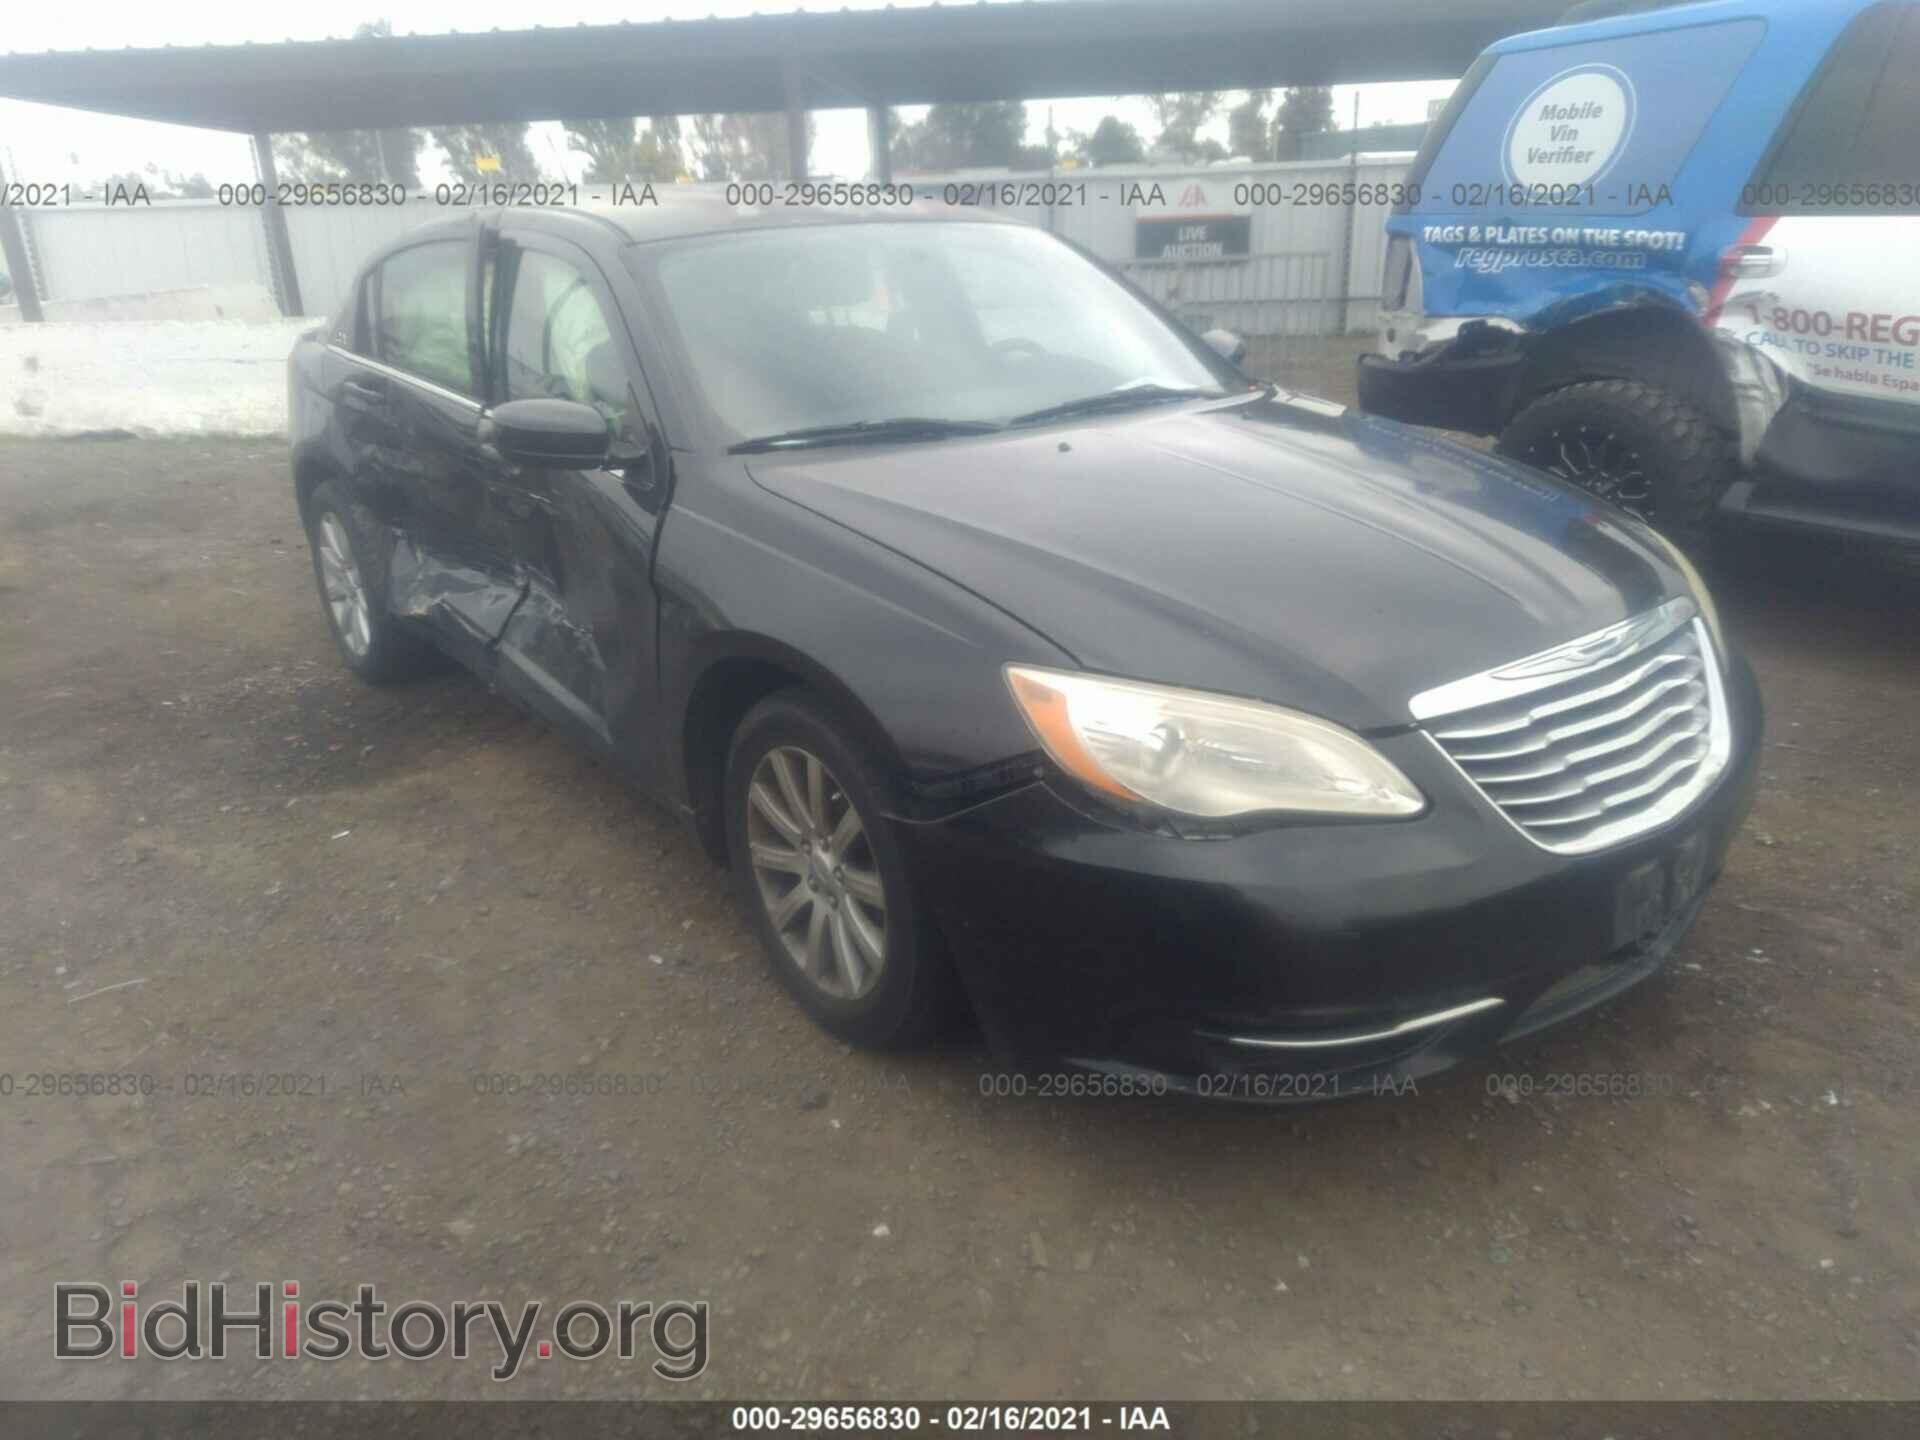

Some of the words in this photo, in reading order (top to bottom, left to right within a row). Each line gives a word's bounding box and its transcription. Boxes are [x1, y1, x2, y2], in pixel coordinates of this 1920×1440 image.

[1539, 102, 1603, 121] Mobile
[1549, 124, 1578, 142] Vin
[1526, 146, 1595, 165] Verifier
[1178, 223, 1208, 241] LIVE
[1424, 226, 1464, 242] TAGS
[1468, 226, 1481, 241] &
[1485, 227, 1547, 244] PLATES
[1551, 228, 1581, 244] ON
[1583, 229, 1619, 246] THE
[1623, 230, 1686, 250] SPOT!
[1162, 241, 1223, 258] AUCTION
[1454, 247, 1646, 273] regprosca.com
[1795, 338, 1821, 355] TO
[1824, 342, 1870, 362] SKIP
[1872, 348, 1915, 369] THE
[1834, 364, 1878, 386] habla
